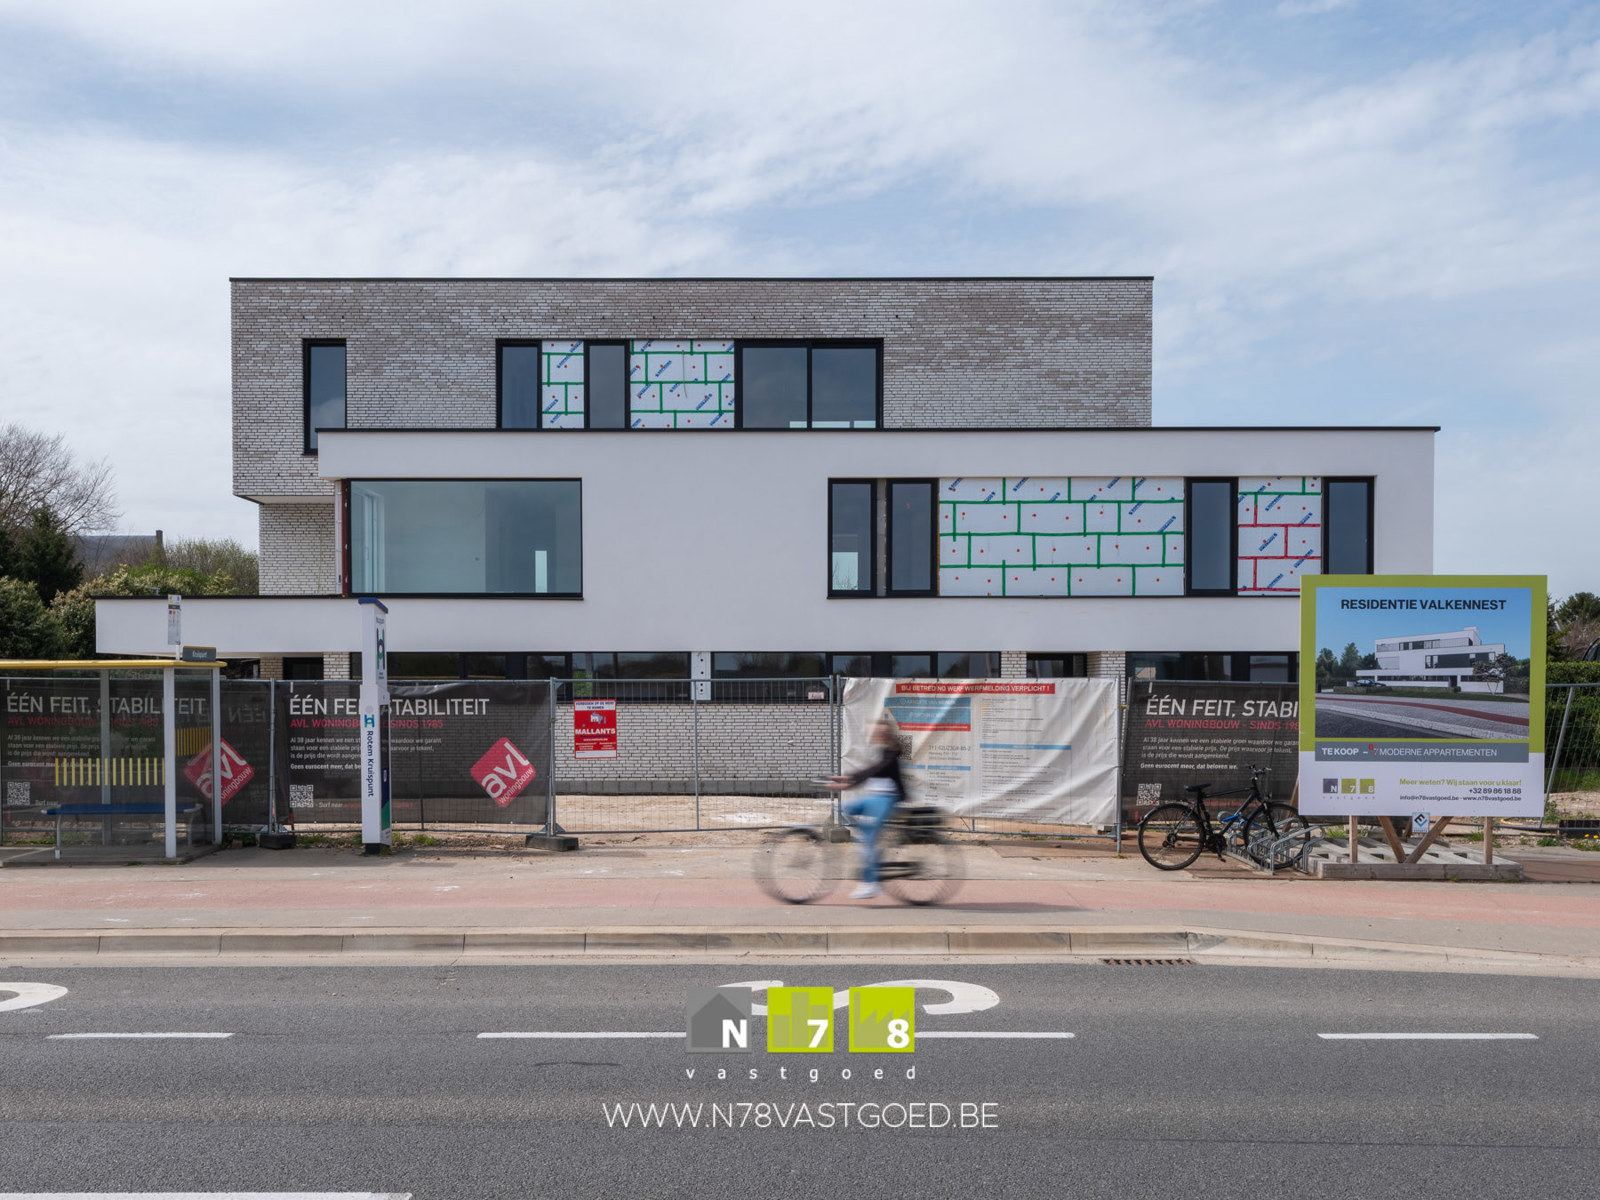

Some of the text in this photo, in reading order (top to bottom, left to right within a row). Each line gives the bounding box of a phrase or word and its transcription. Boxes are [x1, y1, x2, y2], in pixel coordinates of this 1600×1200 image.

[1341, 599, 1507, 610] RESIDENTIE VALKENNEST
[7, 692, 43, 713] ÉÉN
[290, 694, 327, 715] ÉÉN
[1146, 695, 1298, 718] ÉÉN FEIT, STABI
[290, 718, 308, 728] AVL
[312, 718, 361, 728] WONINGB
[391, 719, 419, 728] SINDS
[1145, 719, 1165, 729] AVL
[1167, 719, 1240, 730] WONINGBOUW
[1249, 720, 1281, 730] SINDS
[1285, 721, 1299, 730] 198
[1322, 747, 1332, 755] TE
[1334, 747, 1359, 755] KOOP
[1379, 748, 1421, 756] MODERNE
[1423, 748, 1498, 757] APPARTEMENTEN
[366, 759, 374, 797] Kruispunt
[481, 741, 530, 798] avl
[500, 767, 534, 804] woningbouw
[1447, 779, 1458, 787] Wij
